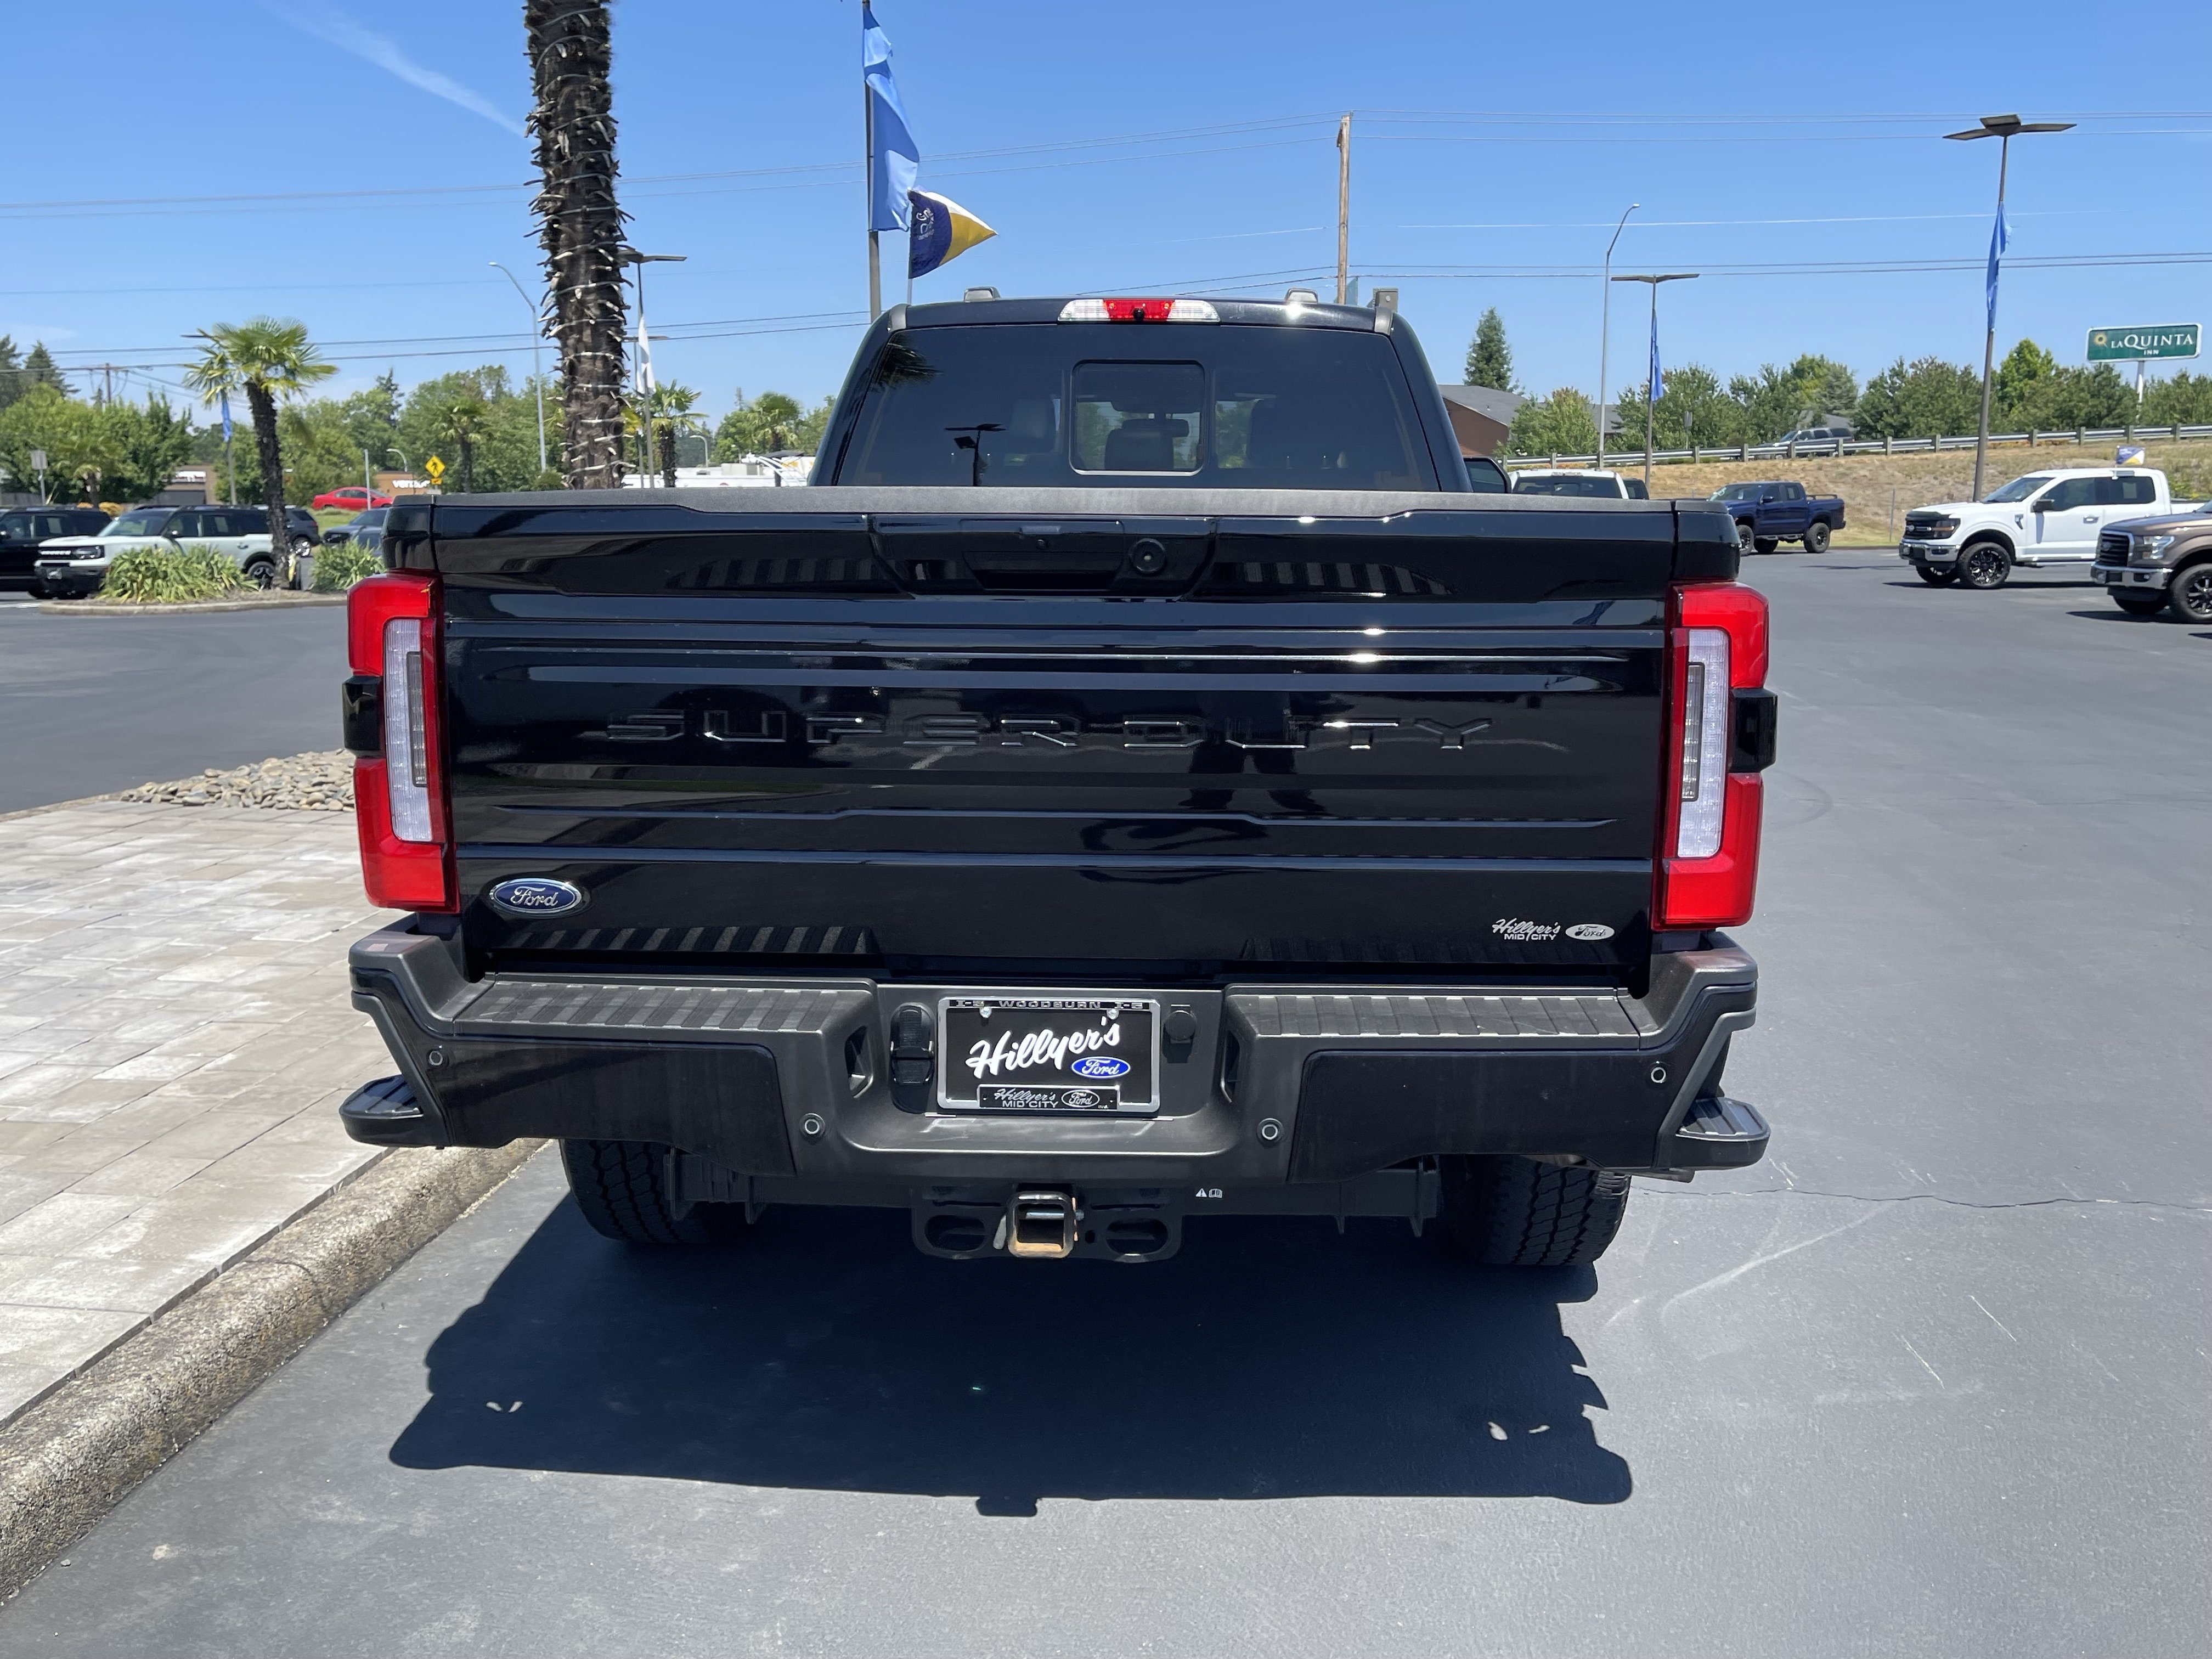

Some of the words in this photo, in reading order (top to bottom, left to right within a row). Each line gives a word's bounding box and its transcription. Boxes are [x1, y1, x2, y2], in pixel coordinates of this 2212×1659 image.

[2111, 340, 2123, 348] LA
[2124, 334, 2193, 350] QUINTA
[607, 709, 1083, 747] SUPER
[1124, 713, 1493, 750] DUTY
[510, 886, 559, 906] Ford
[1492, 918, 1561, 941] Hillyer's
[1575, 925, 1606, 937] Ford
[998, 1001, 1101, 1009] WOODBURN
[965, 1015, 1120, 1079] Hillyer's
[1081, 1058, 1120, 1075] Ford
[994, 1088, 1057, 1104] Hillyer's
[1069, 1092, 1093, 1105] Ford
